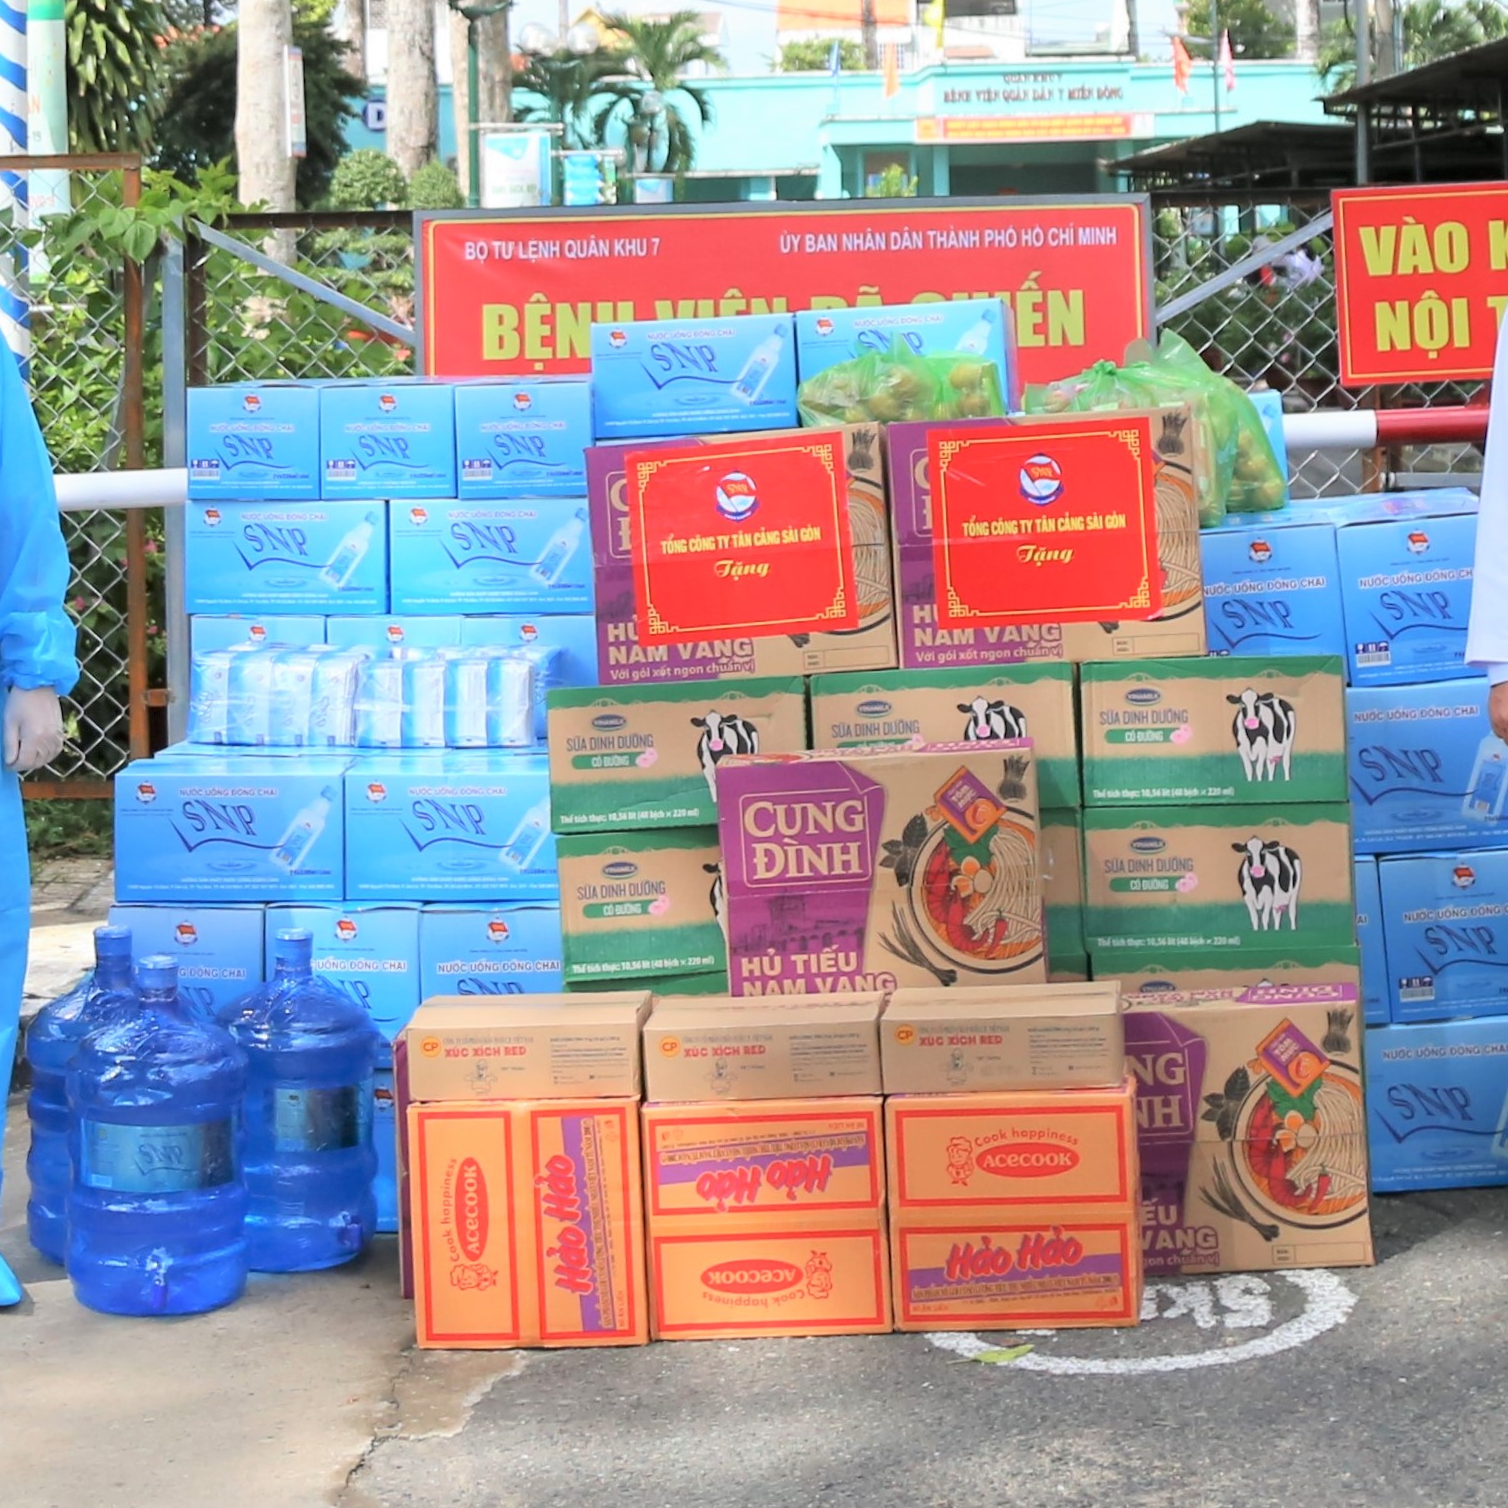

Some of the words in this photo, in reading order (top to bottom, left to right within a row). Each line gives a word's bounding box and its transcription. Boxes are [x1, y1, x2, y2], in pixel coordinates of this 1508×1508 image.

[465, 239, 491, 262] BỘ
[494, 238, 516, 261] TƯ
[519, 235, 561, 262] LỆNH
[563, 232, 611, 260] QUÂN
[613, 238, 648, 259] KHU
[651, 238, 661, 257] 7
[779, 228, 802, 254] ỦY
[805, 233, 840, 254] BAN
[843, 228, 885, 252] NHÂN
[889, 227, 923, 251] DÂN
[926, 224, 980, 250] THÀNH
[984, 223, 1018, 248] PHỐ
[1022, 223, 1046, 248] HỒ
[1048, 223, 1076, 247] CHÍ
[1079, 225, 1118, 247] MINH
[1358, 216, 1470, 277] VÀO
[1374, 289, 1471, 360] NỘI
[962, 514, 989, 537] TỔNG
[991, 515, 1018, 536] CÔNG
[1019, 516, 1034, 534] TY
[1034, 514, 1056, 534] TÂN
[1057, 511, 1085, 533] CẢNG
[1086, 511, 1104, 531] SÀI
[1105, 511, 1126, 530] GÒN
[661, 532, 688, 555] TỔNG
[689, 532, 715, 553] CÔNG
[715, 533, 731, 550] TY
[731, 529, 753, 549] TÂN
[754, 526, 780, 548] CẢNG
[781, 526, 800, 545] SÀI
[800, 524, 821, 543] GÒN
[713, 558, 771, 581] Tặng
[1017, 545, 1075, 567] Tặng
[913, 624, 974, 647] NAM
[609, 642, 669, 666] NAM
[916, 649, 936, 663] Với
[937, 648, 957, 664] gói
[958, 646, 978, 661] xốt
[980, 648, 1012, 663] ngon
[610, 666, 630, 681] Với
[632, 666, 651, 682] gói
[652, 664, 671, 679] xốt
[673, 665, 705, 680] ngon
[1123, 710, 1149, 725] DINH
[1453, 704, 1479, 717] CHAI
[589, 735, 616, 751] DINH
[1358, 745, 1444, 784] SNP
[744, 798, 865, 838] CUNG
[751, 838, 865, 881] ĐÌNH
[1424, 924, 1498, 956] SNP
[741, 947, 782, 978] HỦ
[790, 944, 858, 975] TIẾU
[742, 978, 807, 998] NAM
[504, 1044, 527, 1057] RED
[973, 1129, 1008, 1148] Cook
[1011, 1126, 1080, 1147] happiness
[438, 1155, 458, 1227] happiness
[532, 1153, 582, 1225] Hảo
[694, 1162, 764, 1214] Hảo
[764, 1152, 835, 1202] Hảo
[448, 1227, 462, 1264] Cook
[545, 1223, 594, 1296] Hảo
[944, 1234, 1014, 1282] Hảo
[1015, 1223, 1085, 1272] Hảo
[700, 1289, 771, 1311] happiness
[770, 1287, 806, 1309] Cook
